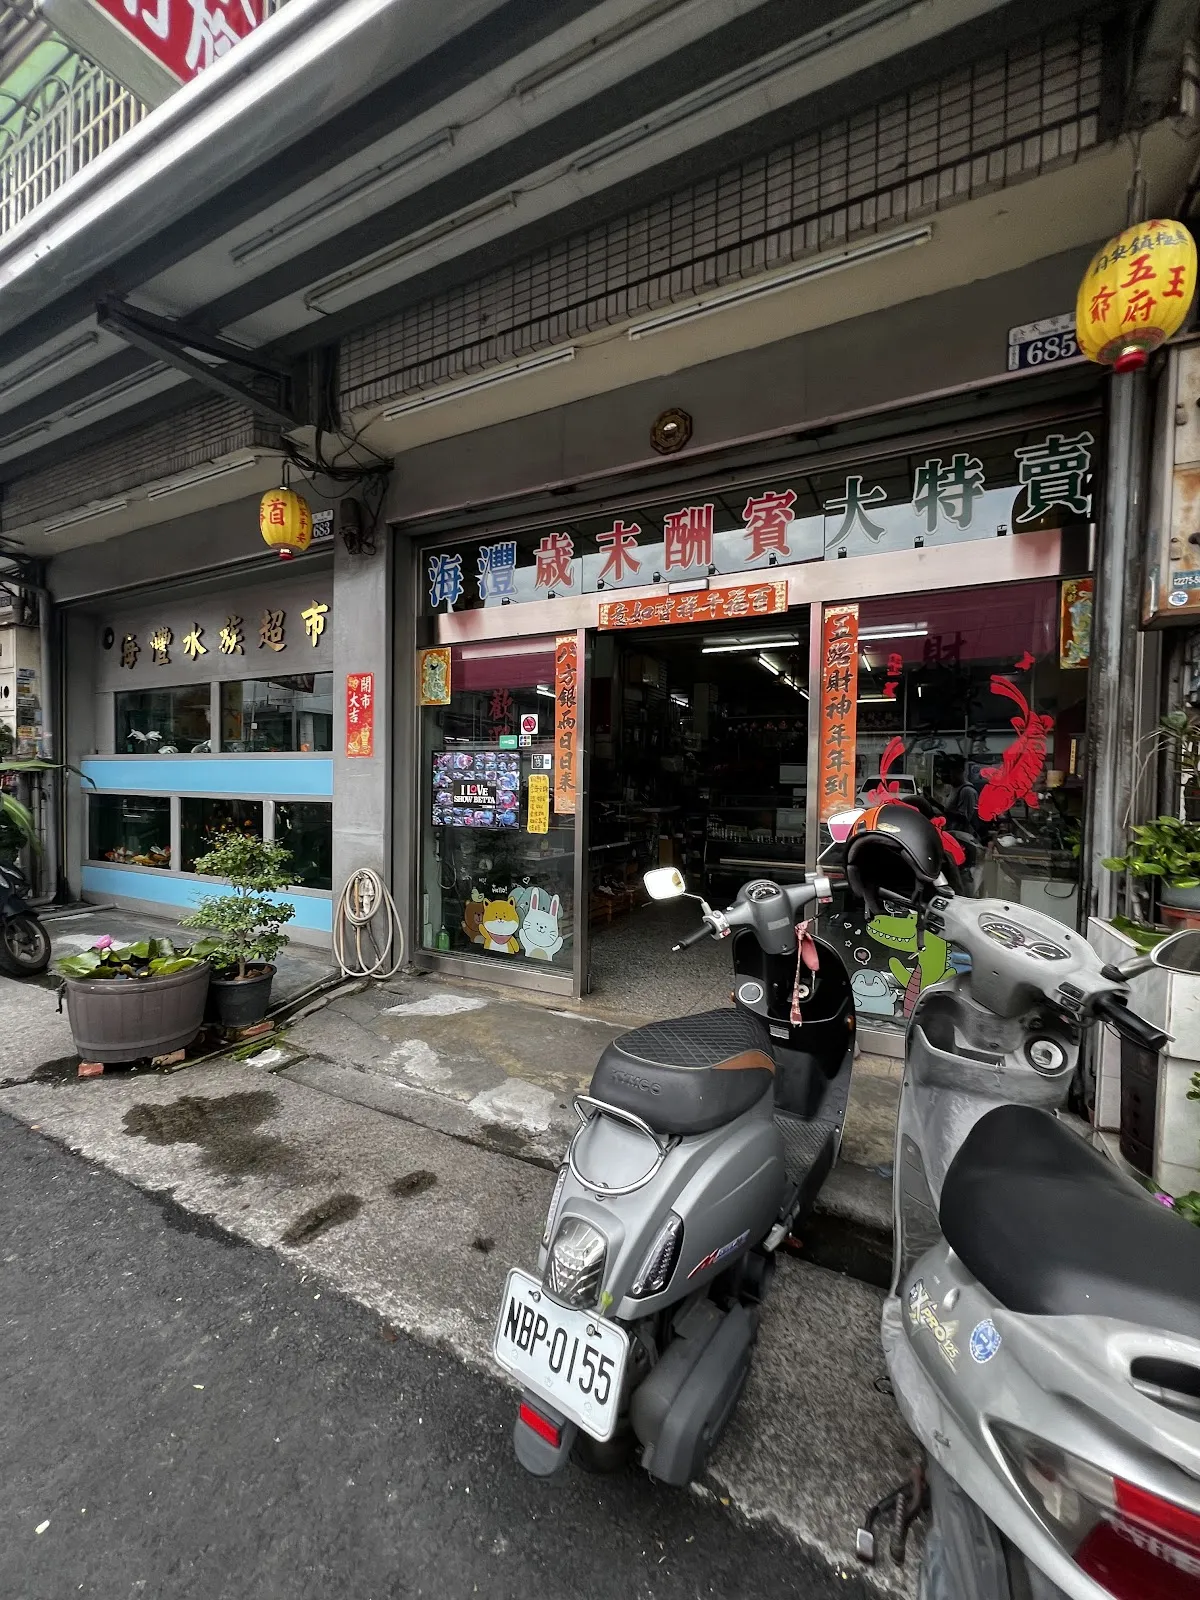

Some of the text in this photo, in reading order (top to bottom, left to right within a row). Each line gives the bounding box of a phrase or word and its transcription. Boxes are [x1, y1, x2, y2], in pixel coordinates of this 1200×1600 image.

[1027, 333, 1077, 364] 685
[313, 522, 330, 537] 683
[348, 692, 360, 723] 大吉
[473, 796, 495, 804] BETTA
[503, 1296, 615, 1406] NBP-0155
